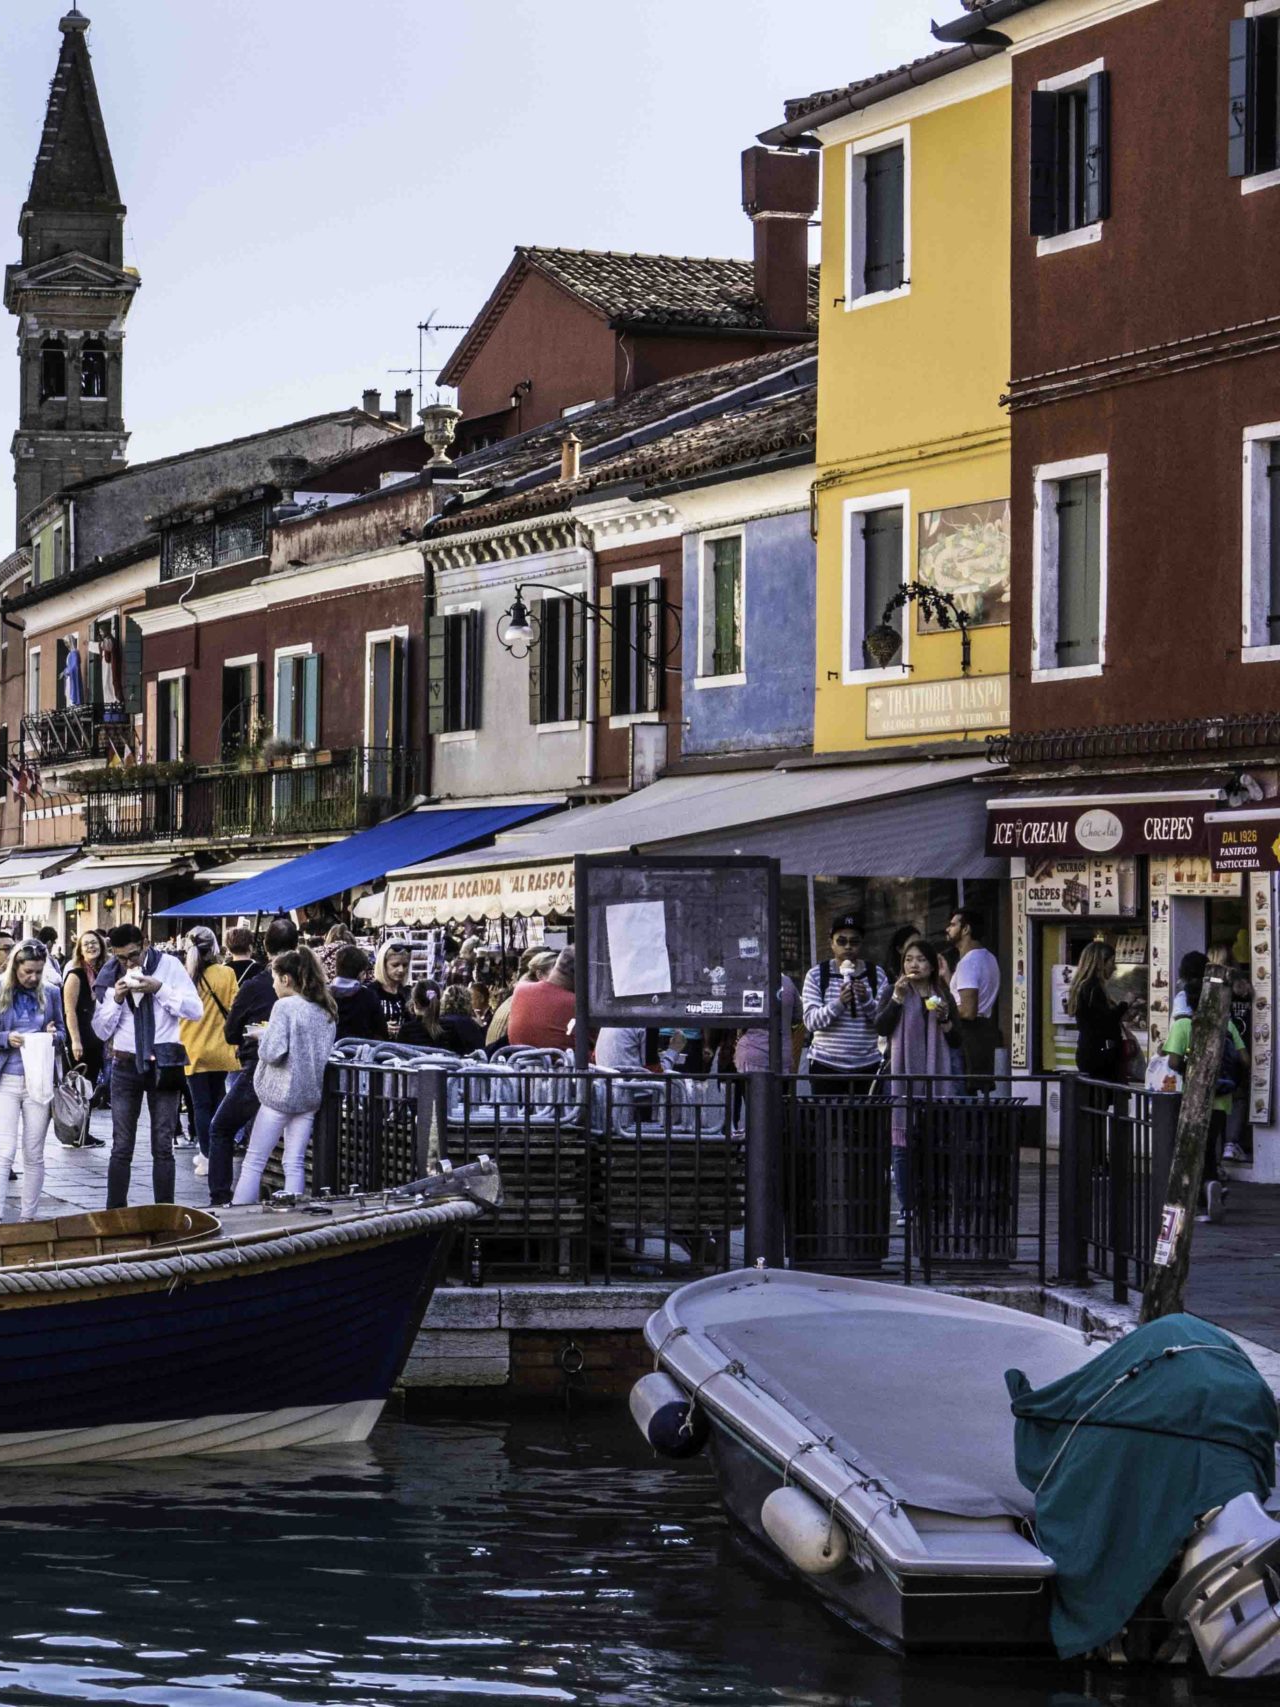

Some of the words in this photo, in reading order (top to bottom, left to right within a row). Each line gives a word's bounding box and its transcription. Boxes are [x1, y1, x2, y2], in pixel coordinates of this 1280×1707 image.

[888, 684, 953, 716] TRATTORIA
[960, 680, 1002, 709] RASPO
[919, 716, 951, 727] SALONE
[993, 822, 1013, 845] ICE
[1022, 821, 1068, 844] CREAM
[1144, 817, 1193, 840] CREPES
[1222, 831, 1238, 844] DAL
[1239, 829, 1258, 843] 1926
[1220, 846, 1258, 857] PANIFICIO
[1056, 862, 1087, 873] CHURROS
[1215, 859, 1261, 869] PASTICCERIA
[392, 882, 448, 903] TRATTORIA
[452, 877, 502, 899] LOCANDA
[527, 870, 565, 890] RASPO
[1094, 857, 1102, 909] UBBLE
[1104, 864, 1114, 898] TEA
[1028, 884, 1061, 900] CRÊPES
